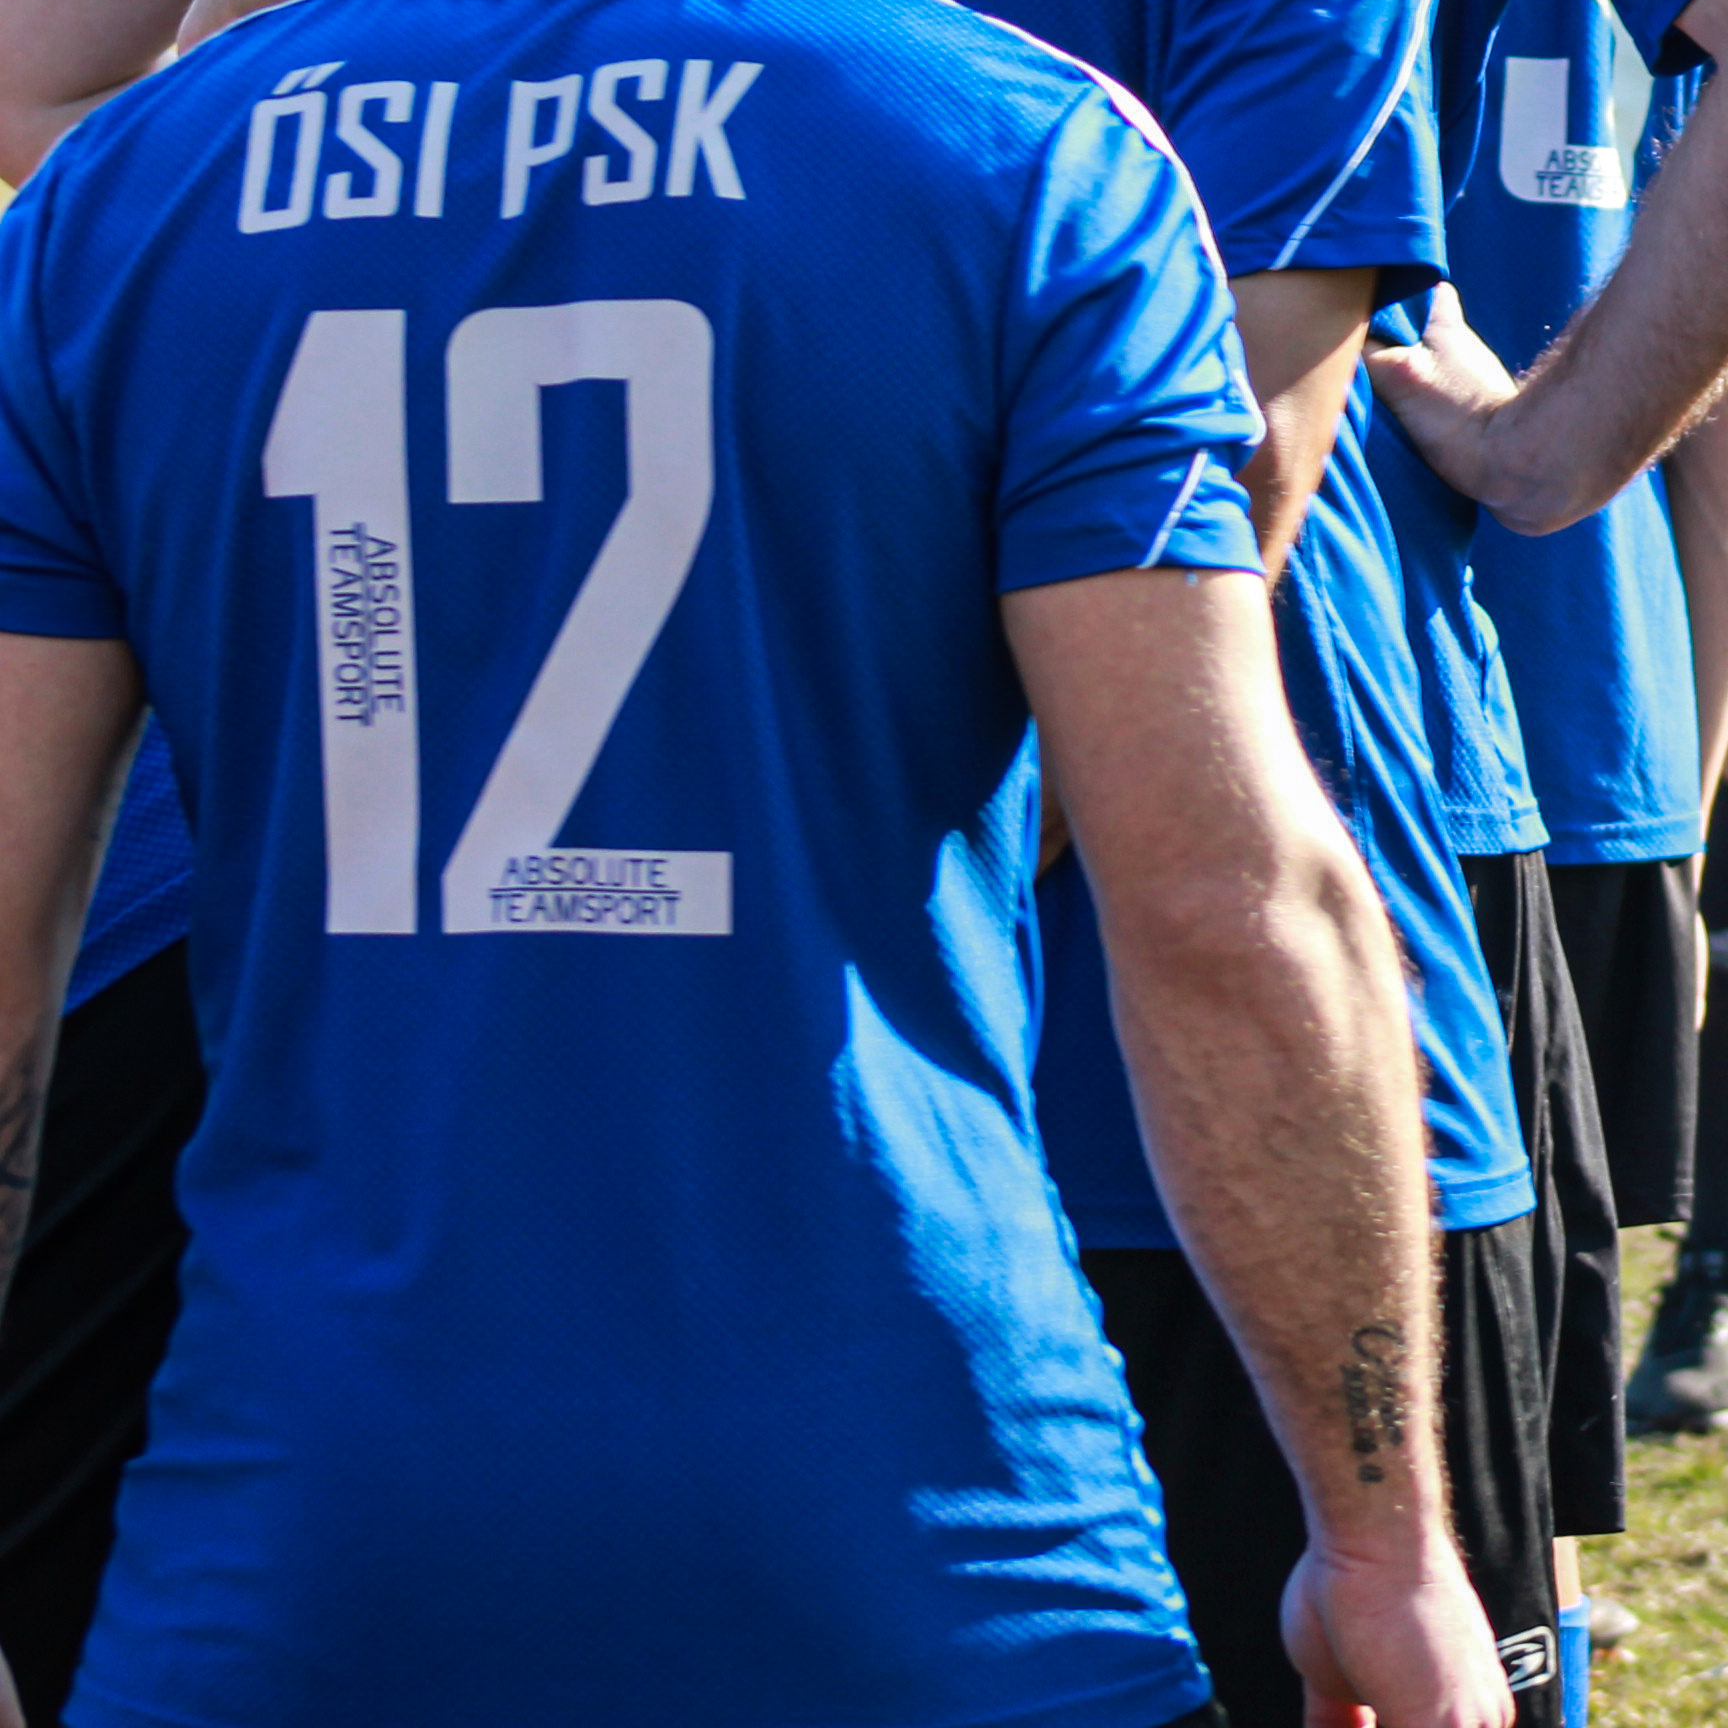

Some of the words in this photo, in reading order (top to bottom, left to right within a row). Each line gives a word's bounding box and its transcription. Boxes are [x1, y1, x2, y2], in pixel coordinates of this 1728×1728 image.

[239, 61, 458, 233] ŐSI
[503, 59, 763, 218] PSK
[264, 299, 731, 934] 12
[329, 522, 374, 727] TEAMSPORT
[366, 535, 405, 712] ABSOLUTE
[490, 892, 680, 925] TEAMSPORT
[501, 855, 669, 888] ABSOLUTE
